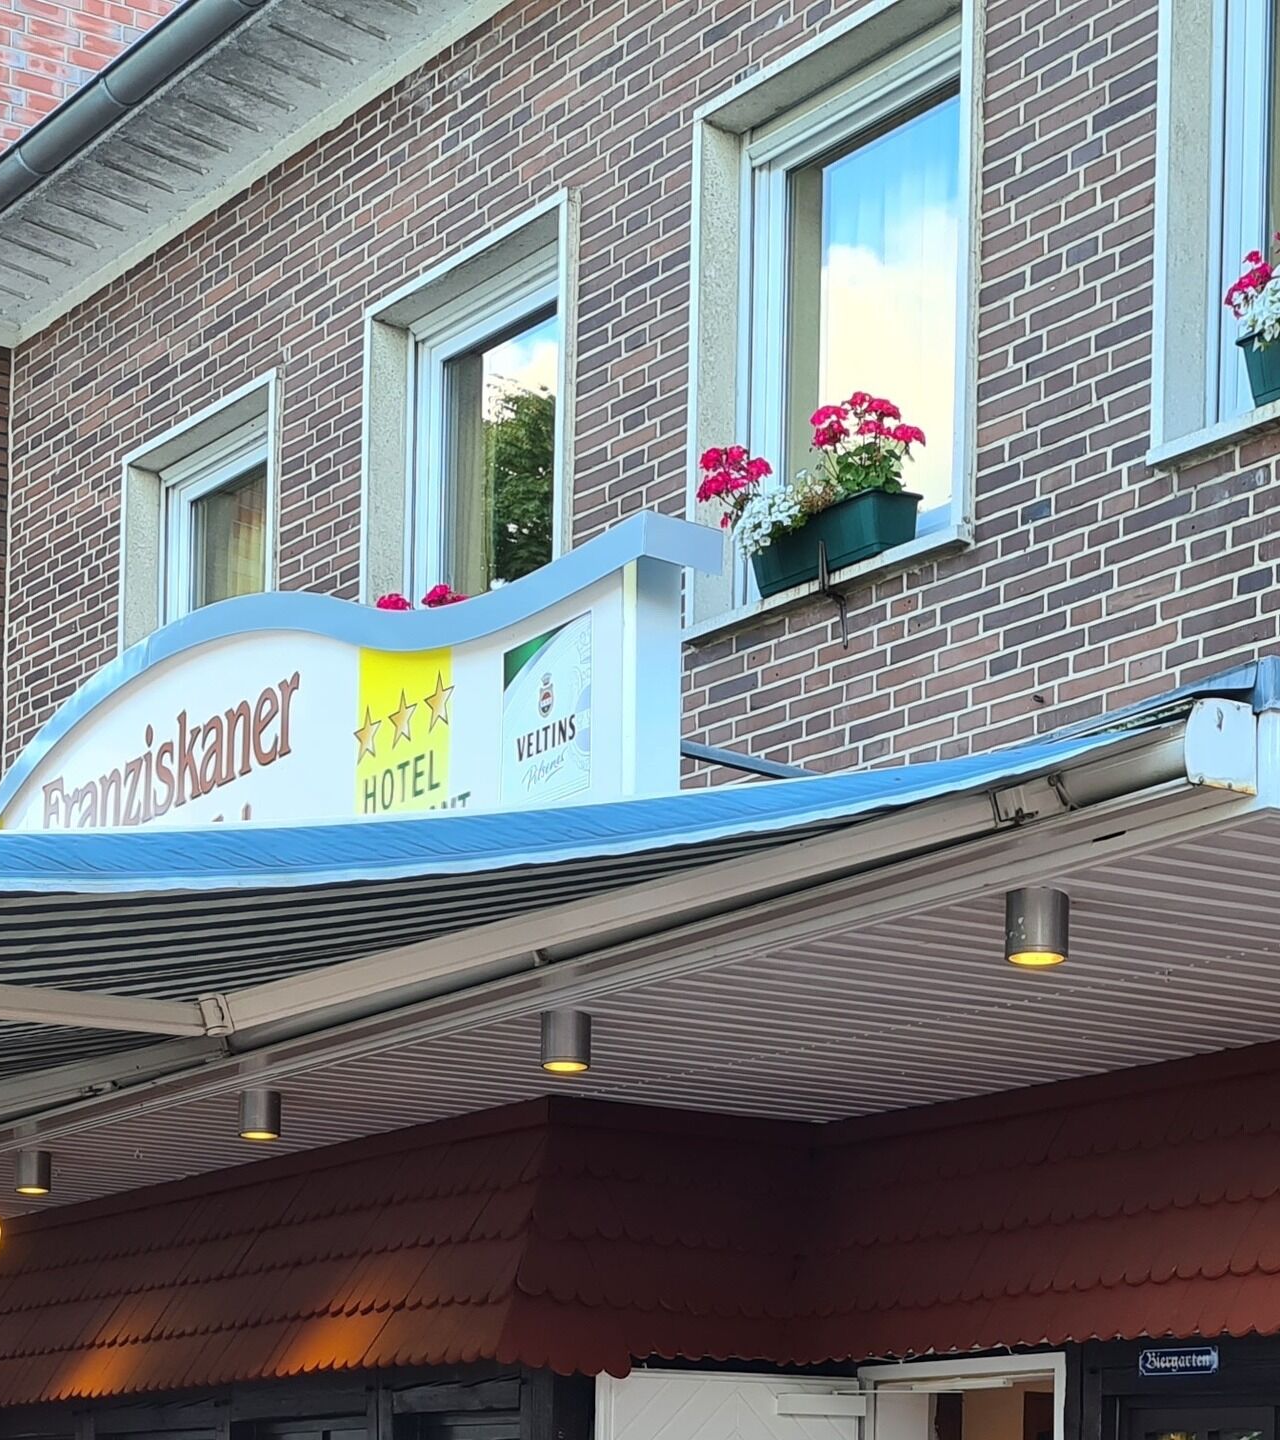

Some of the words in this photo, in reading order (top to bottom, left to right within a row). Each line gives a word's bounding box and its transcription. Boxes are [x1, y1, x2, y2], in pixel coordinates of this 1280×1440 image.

[42, 670, 301, 829] Franziskaner
[516, 713, 577, 763] VELTINS
[363, 749, 441, 814] HOTEL
[1145, 1352, 1210, 1372] Biergarten
